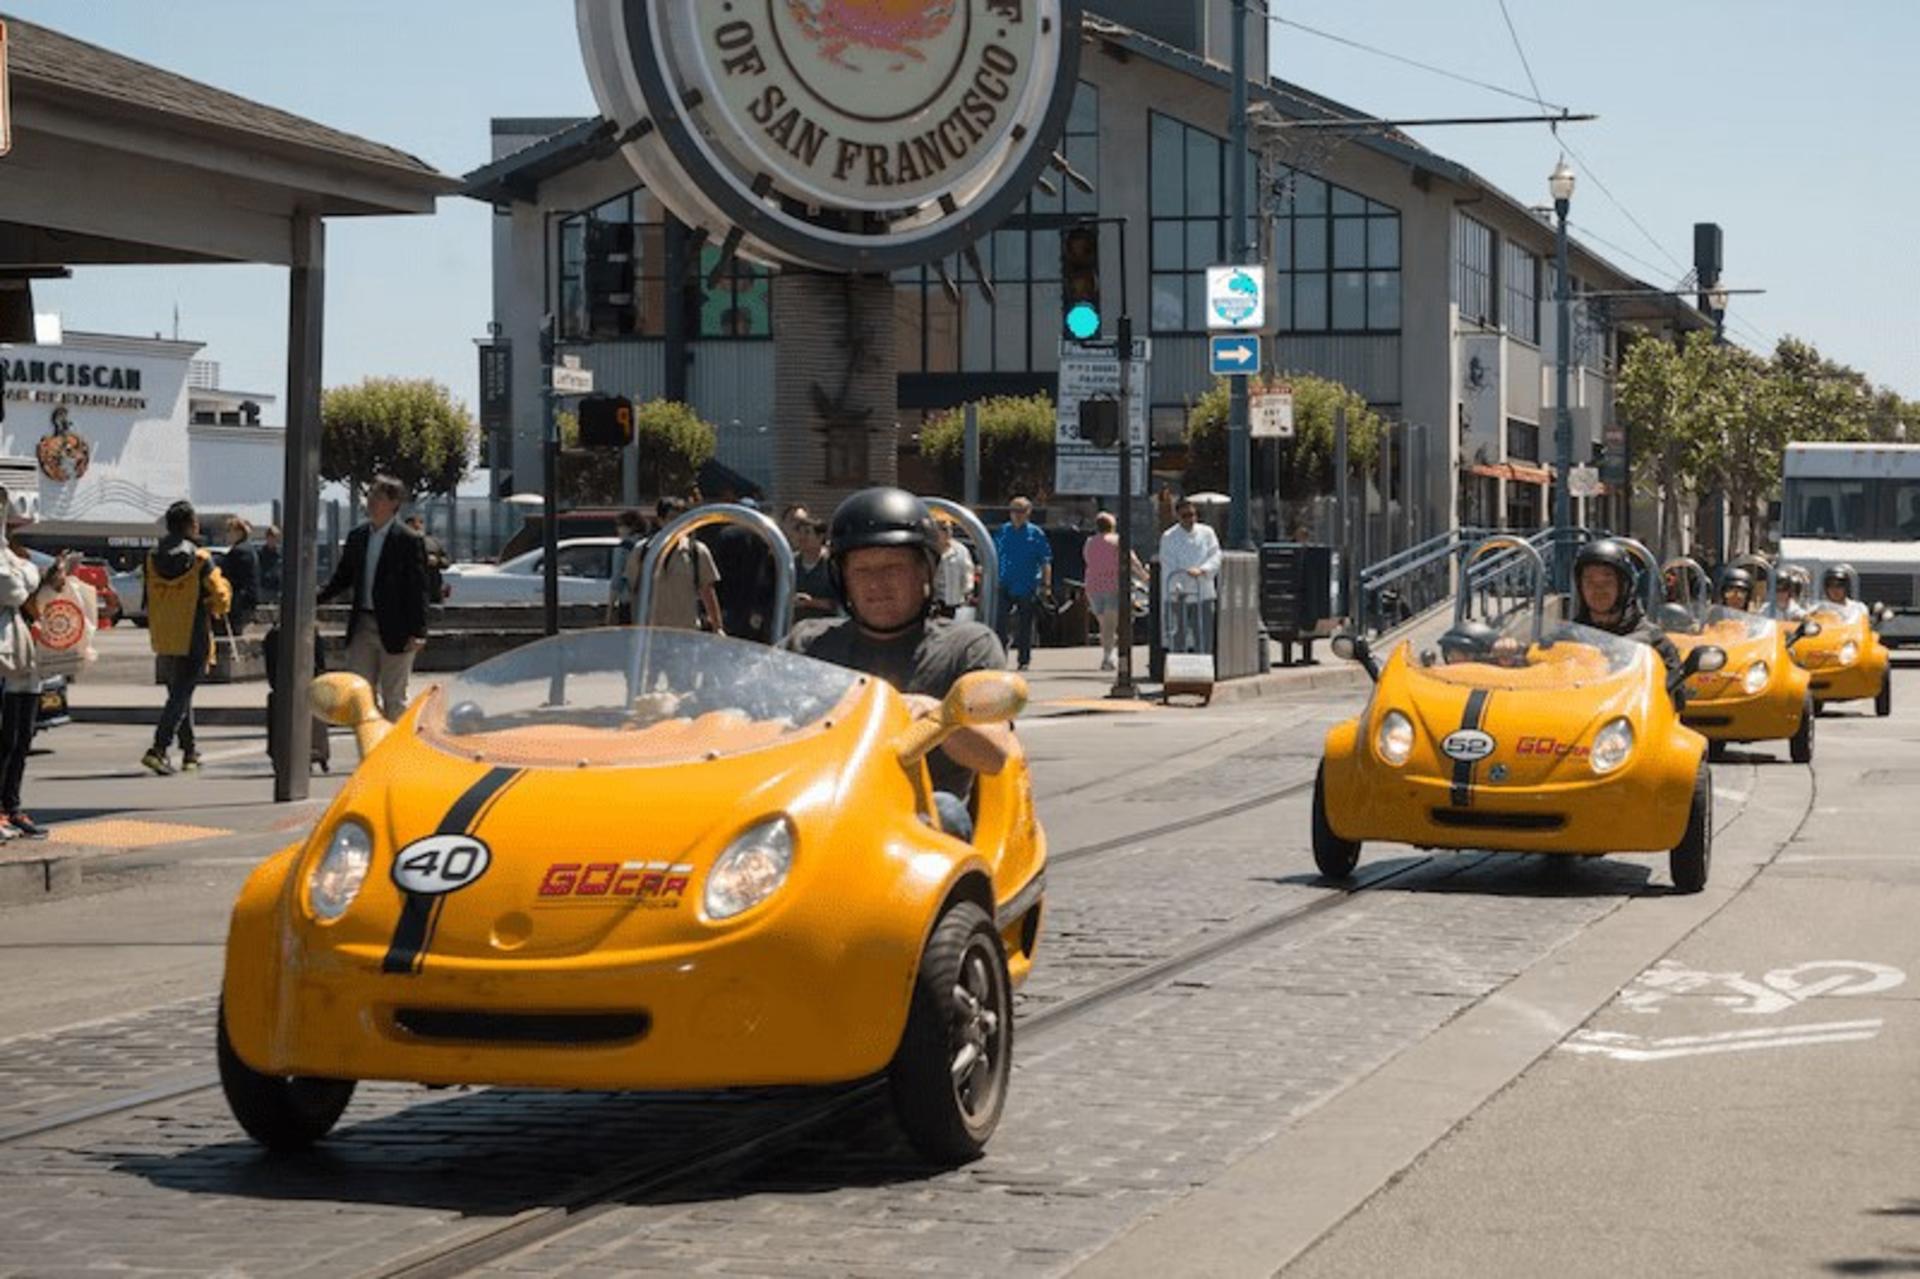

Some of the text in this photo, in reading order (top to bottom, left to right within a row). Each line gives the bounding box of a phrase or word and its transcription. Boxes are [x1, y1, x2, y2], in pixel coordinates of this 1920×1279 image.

[714, 19, 1019, 187] OF SAN FRANCISCO
[1446, 738, 1488, 755] 52
[401, 846, 480, 882] 40
